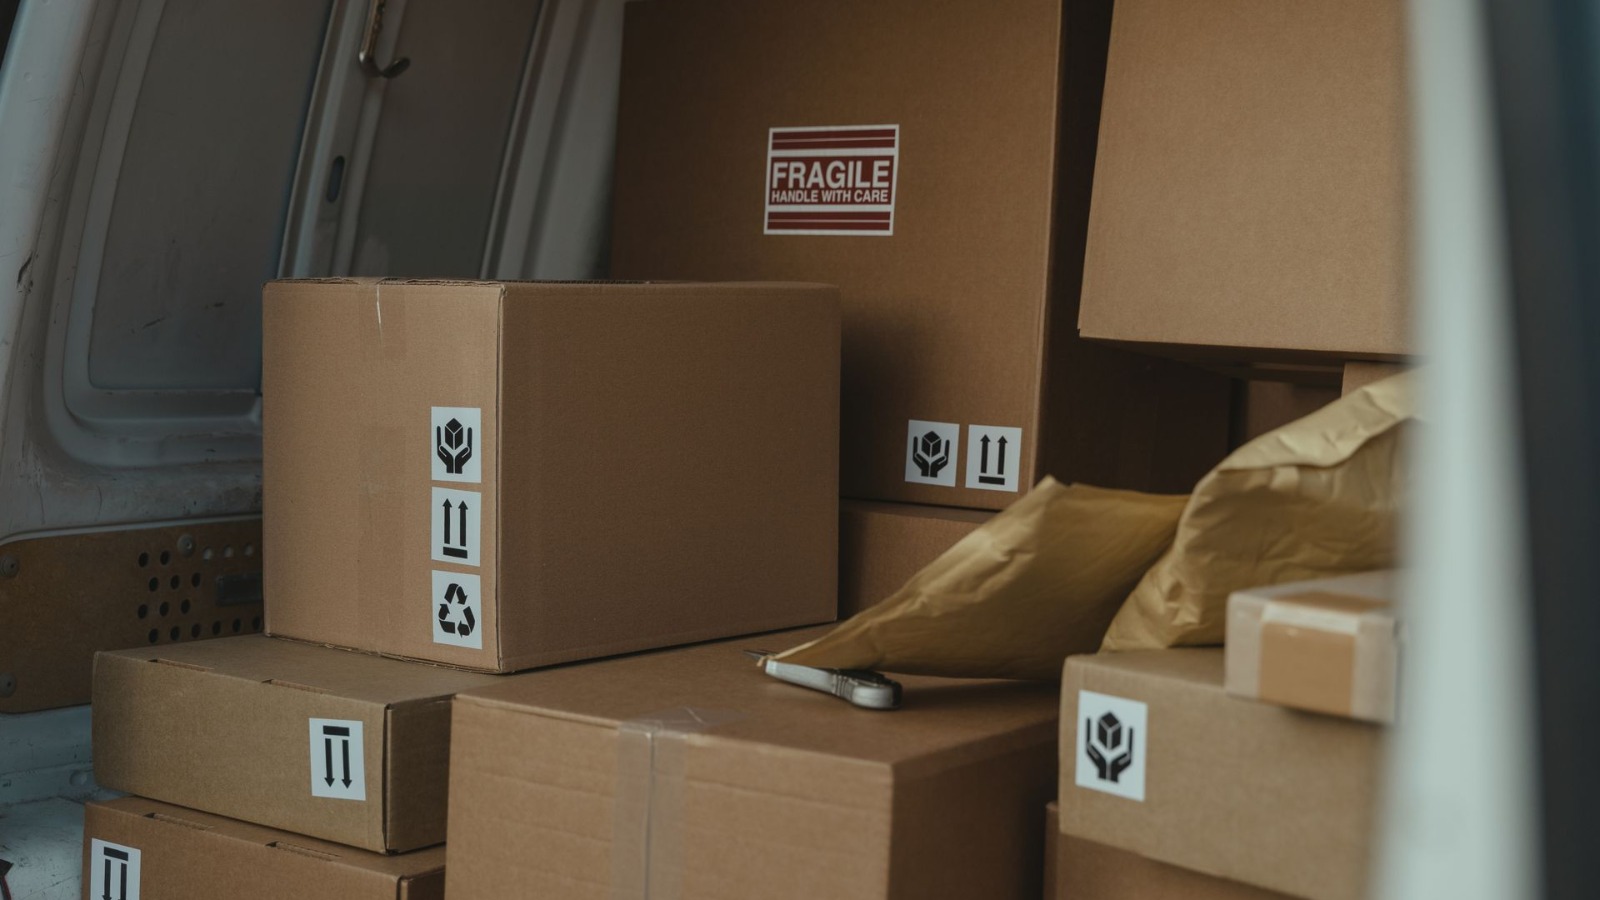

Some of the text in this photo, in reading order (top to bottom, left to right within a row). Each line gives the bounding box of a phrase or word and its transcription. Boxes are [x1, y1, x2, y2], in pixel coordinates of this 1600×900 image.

[772, 160, 890, 189] FRAGILE
[771, 189, 888, 203] HANDLE WITH CARE
